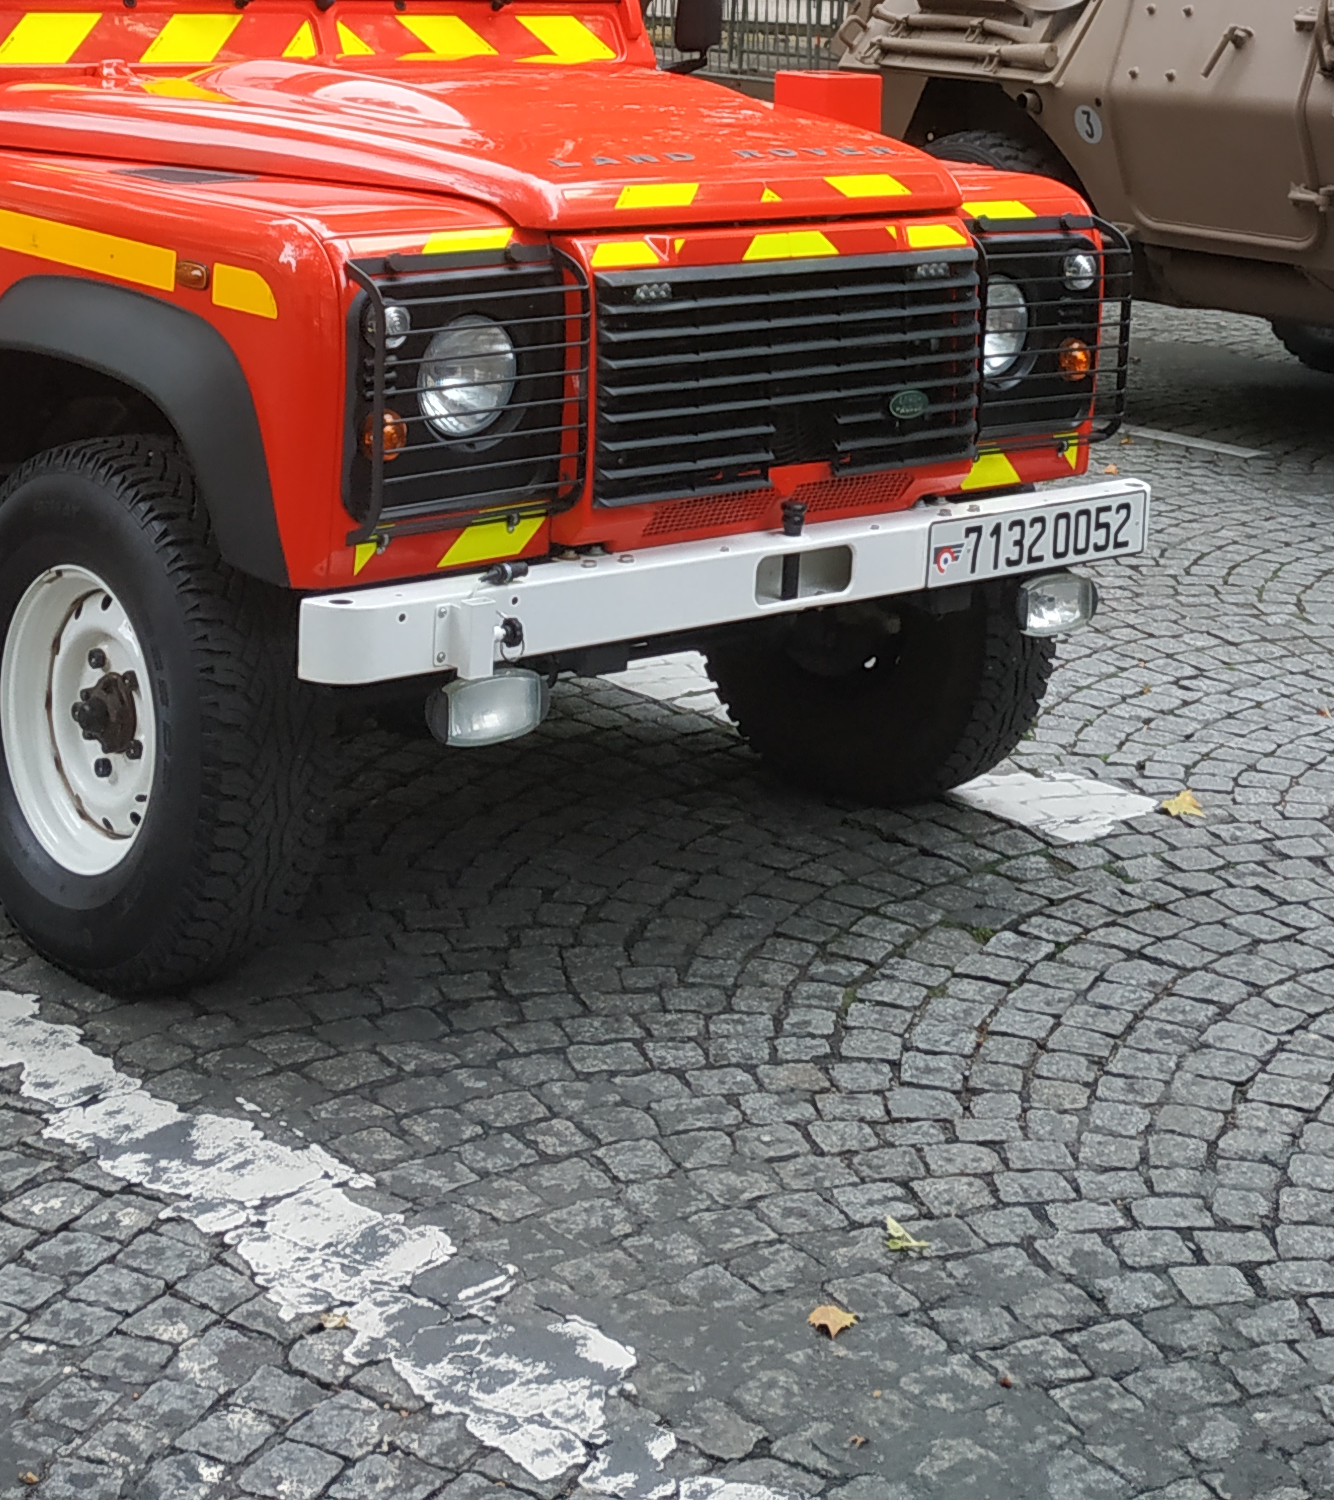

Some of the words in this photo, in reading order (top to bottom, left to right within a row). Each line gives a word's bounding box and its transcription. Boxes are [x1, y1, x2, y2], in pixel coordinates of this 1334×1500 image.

[1080, 109, 1095, 139] 3
[546, 151, 696, 168] LAND
[732, 144, 899, 160] ROVER
